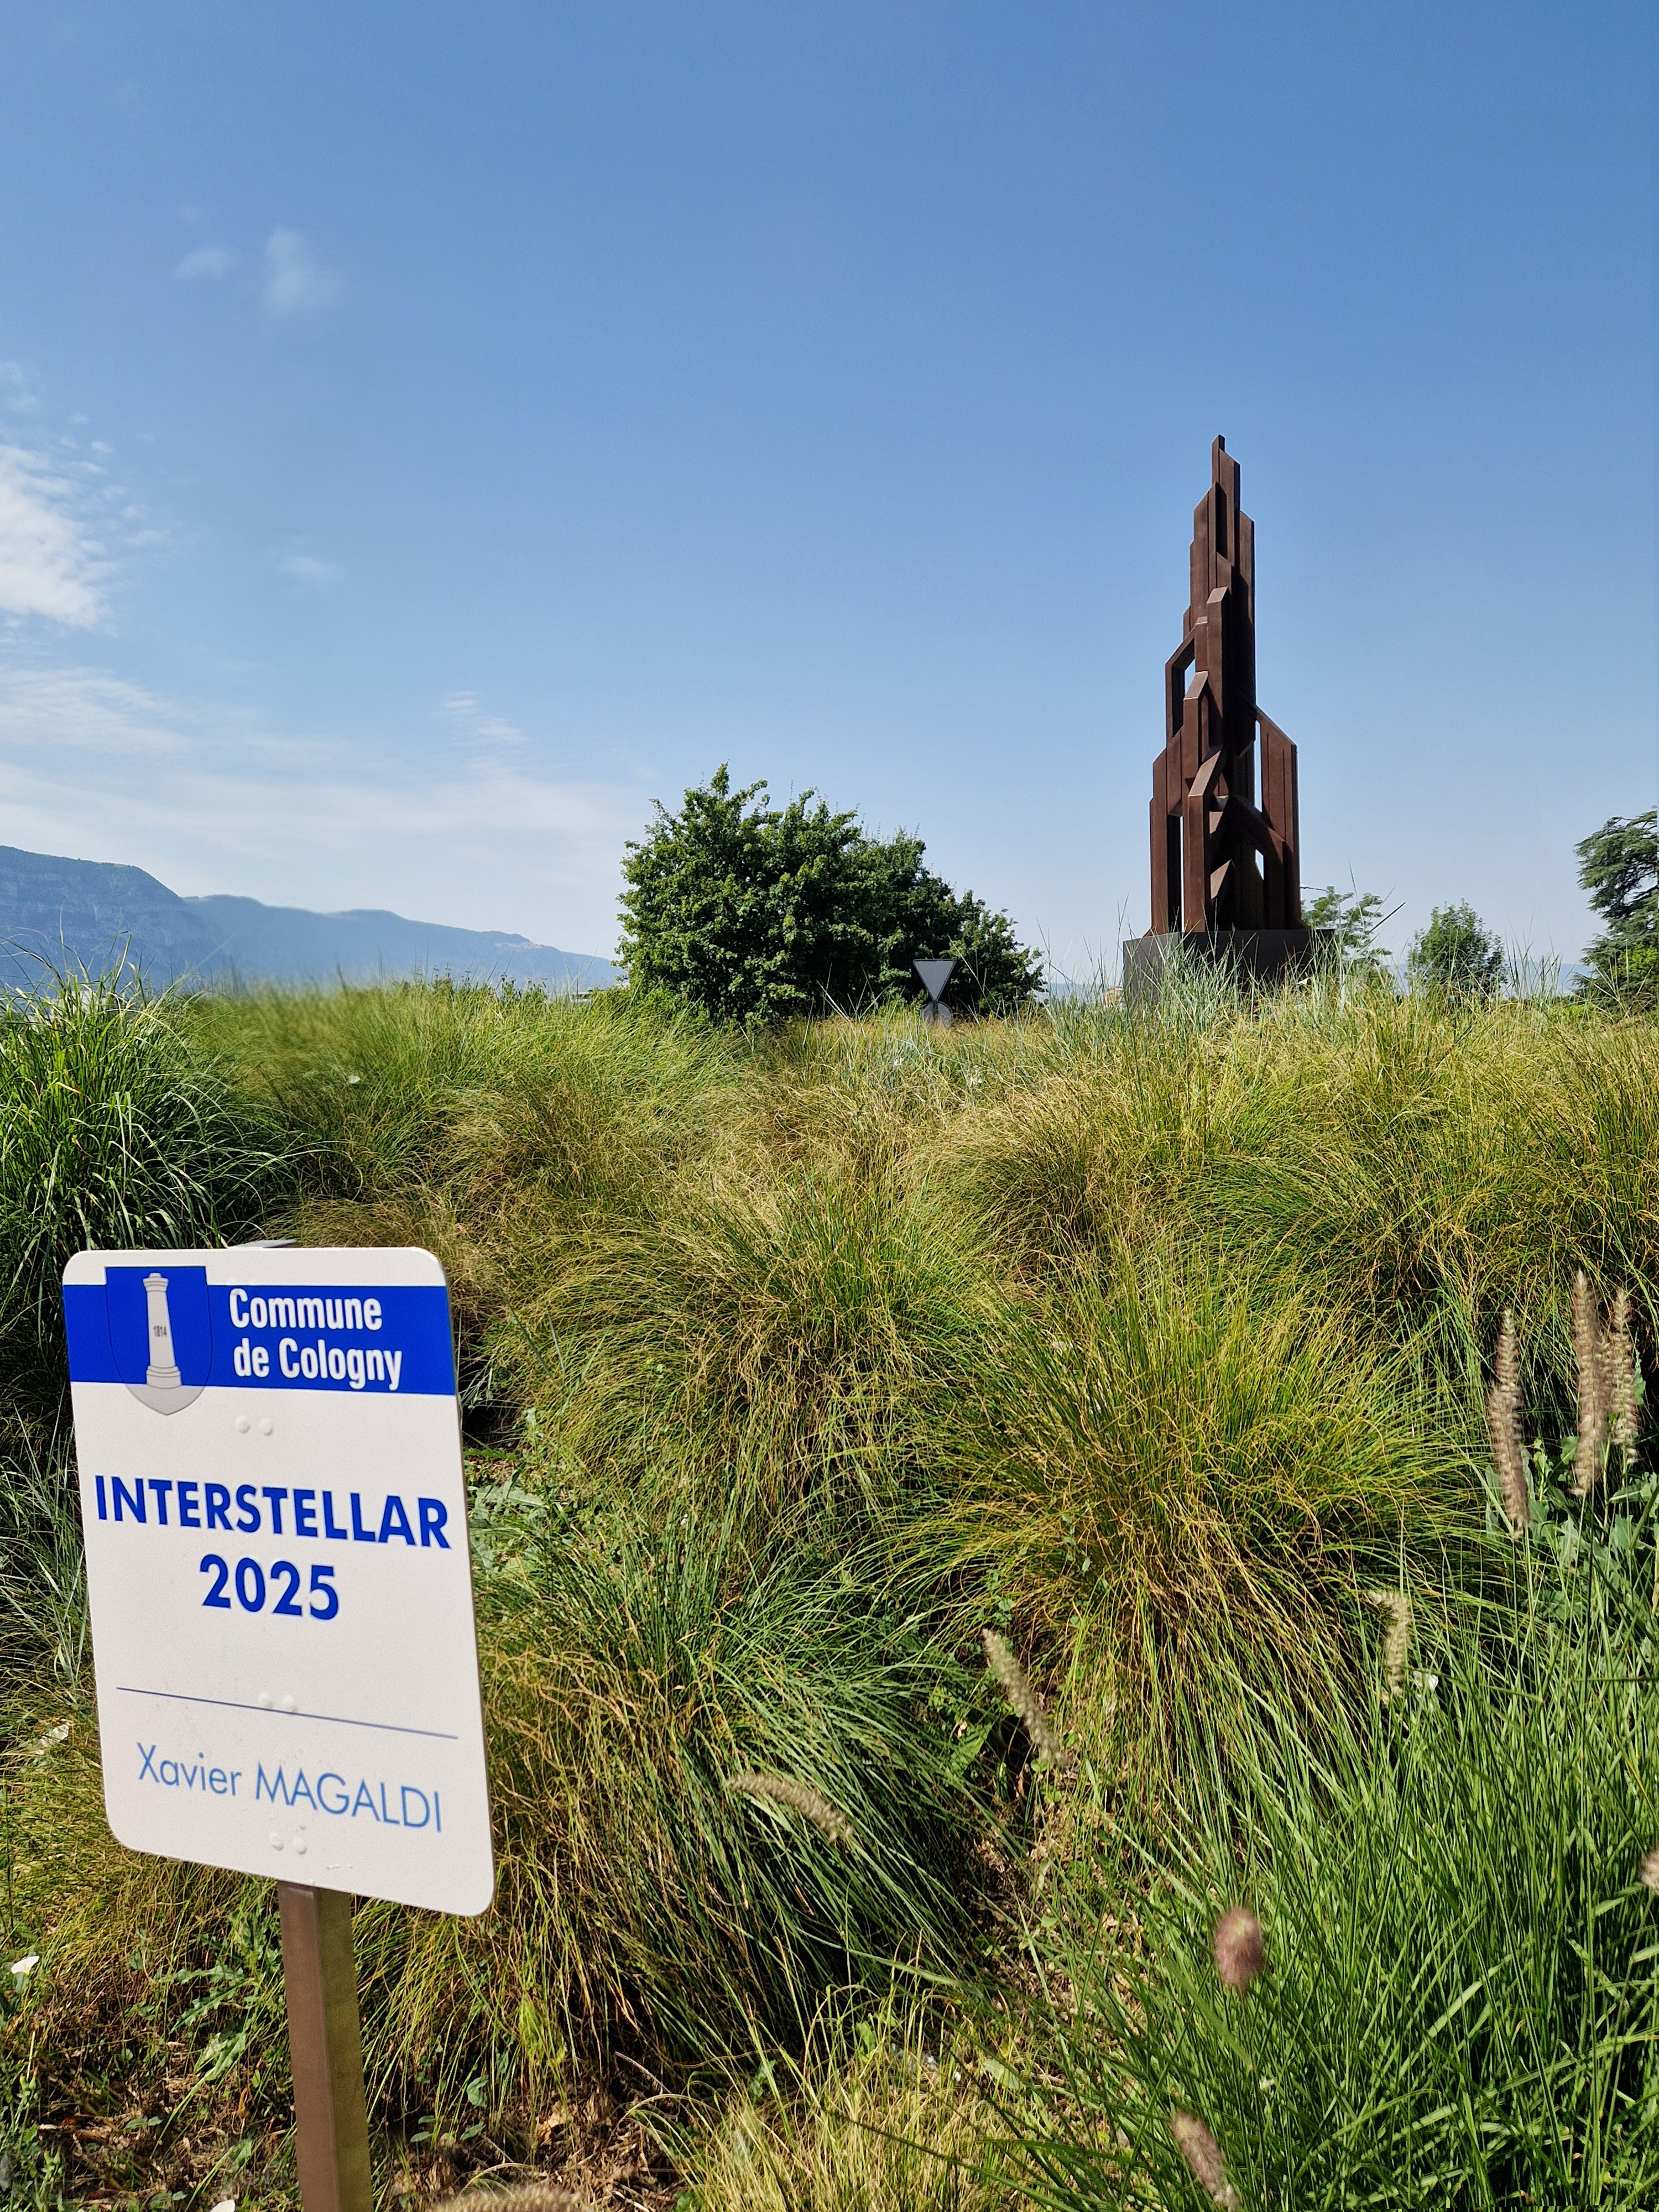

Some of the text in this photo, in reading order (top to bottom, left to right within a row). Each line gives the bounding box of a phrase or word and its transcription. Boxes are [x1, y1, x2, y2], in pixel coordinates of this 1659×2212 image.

[229, 1288, 382, 1330] Commune
[233, 1337, 403, 1391] de Cologny
[95, 1474, 451, 1549] INTERSTELLAR
[199, 1553, 340, 1621] 2025
[136, 1741, 442, 1833] Xavier MAGALDI
